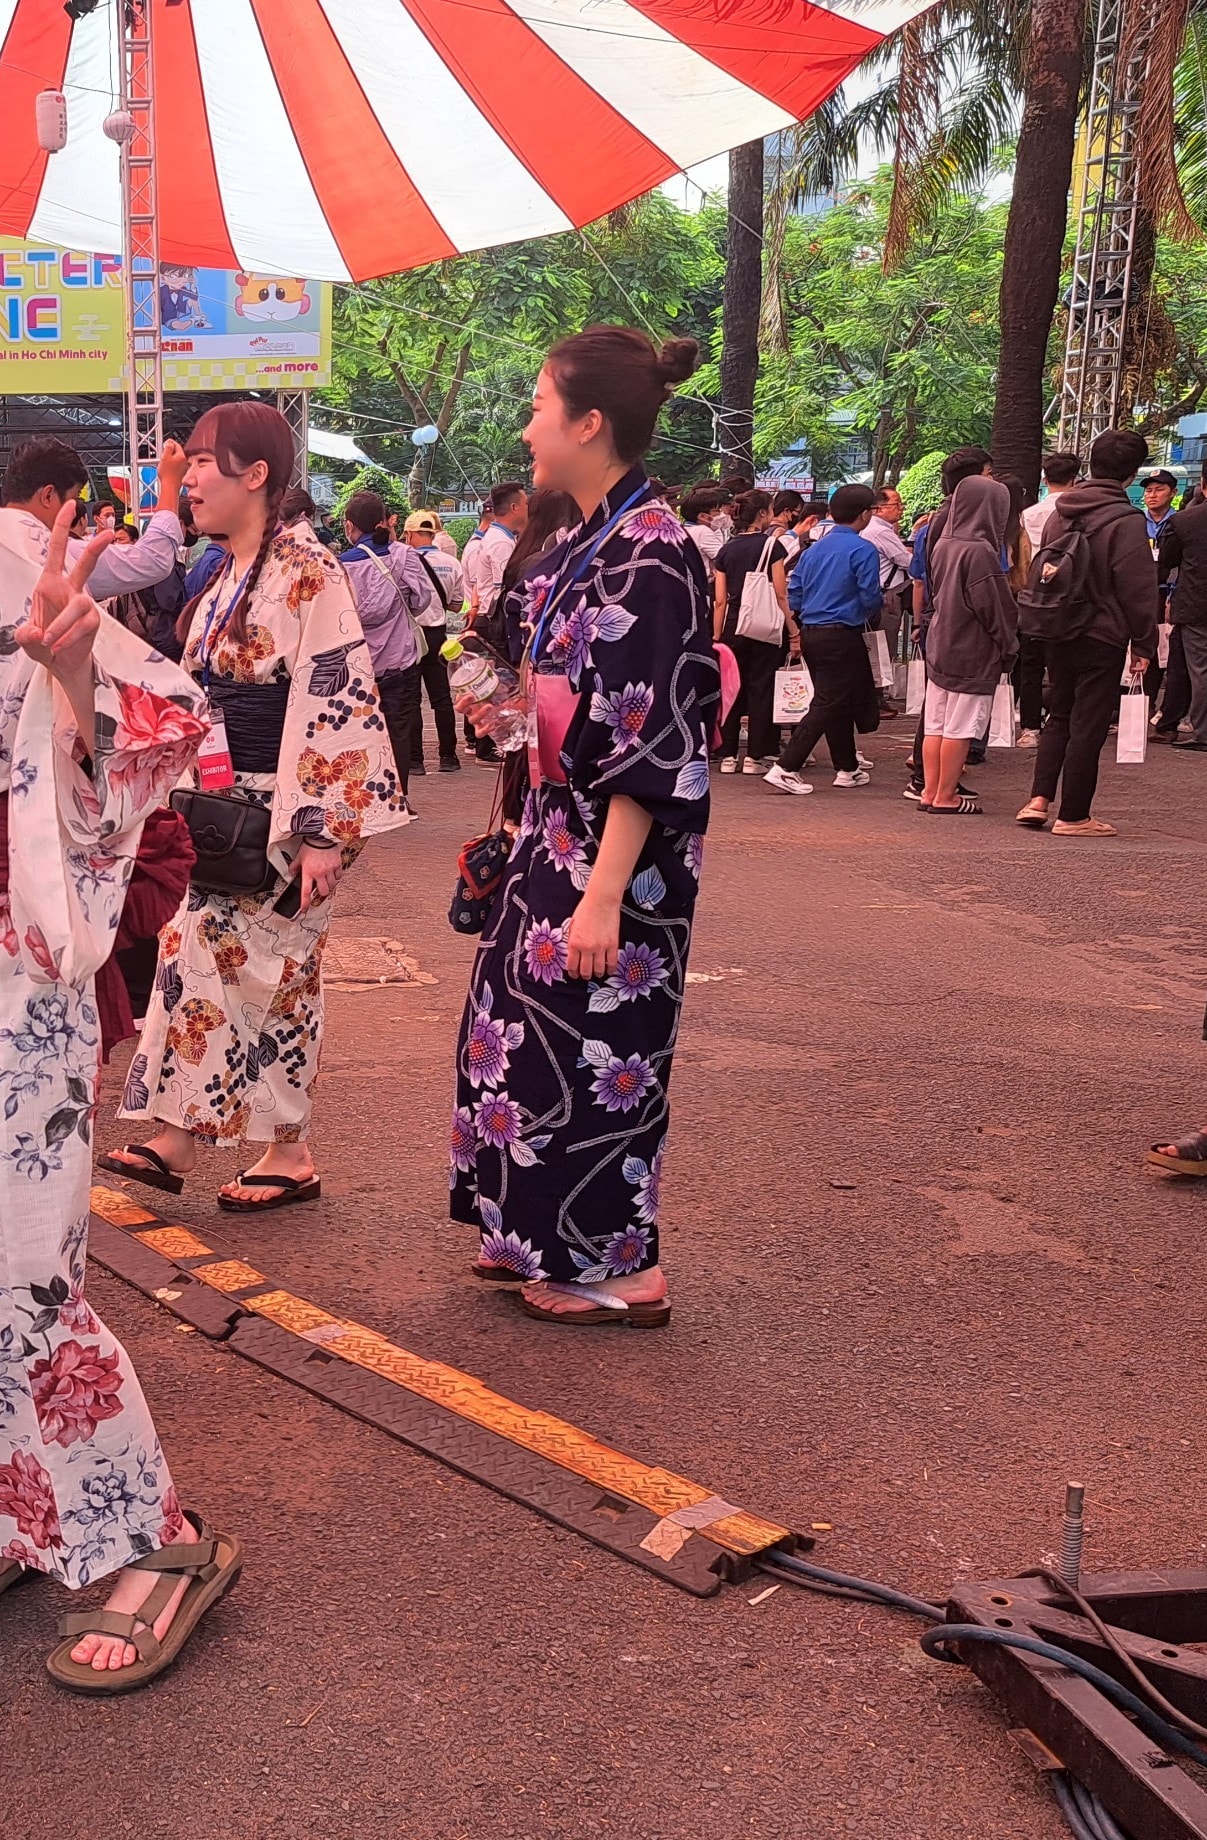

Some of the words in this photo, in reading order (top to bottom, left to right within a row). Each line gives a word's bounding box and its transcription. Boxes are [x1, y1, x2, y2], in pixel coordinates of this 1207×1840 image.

[9, 350, 19, 360] in
[21, 350, 37, 360] Ho
[39, 350, 57, 360] Chi
[59, 349, 86, 359] Minh
[88, 349, 108, 361] city
[255, 363, 282, 374] ...and
[284, 361, 319, 373] more
[202, 764, 228, 776] EXHIBITOR
